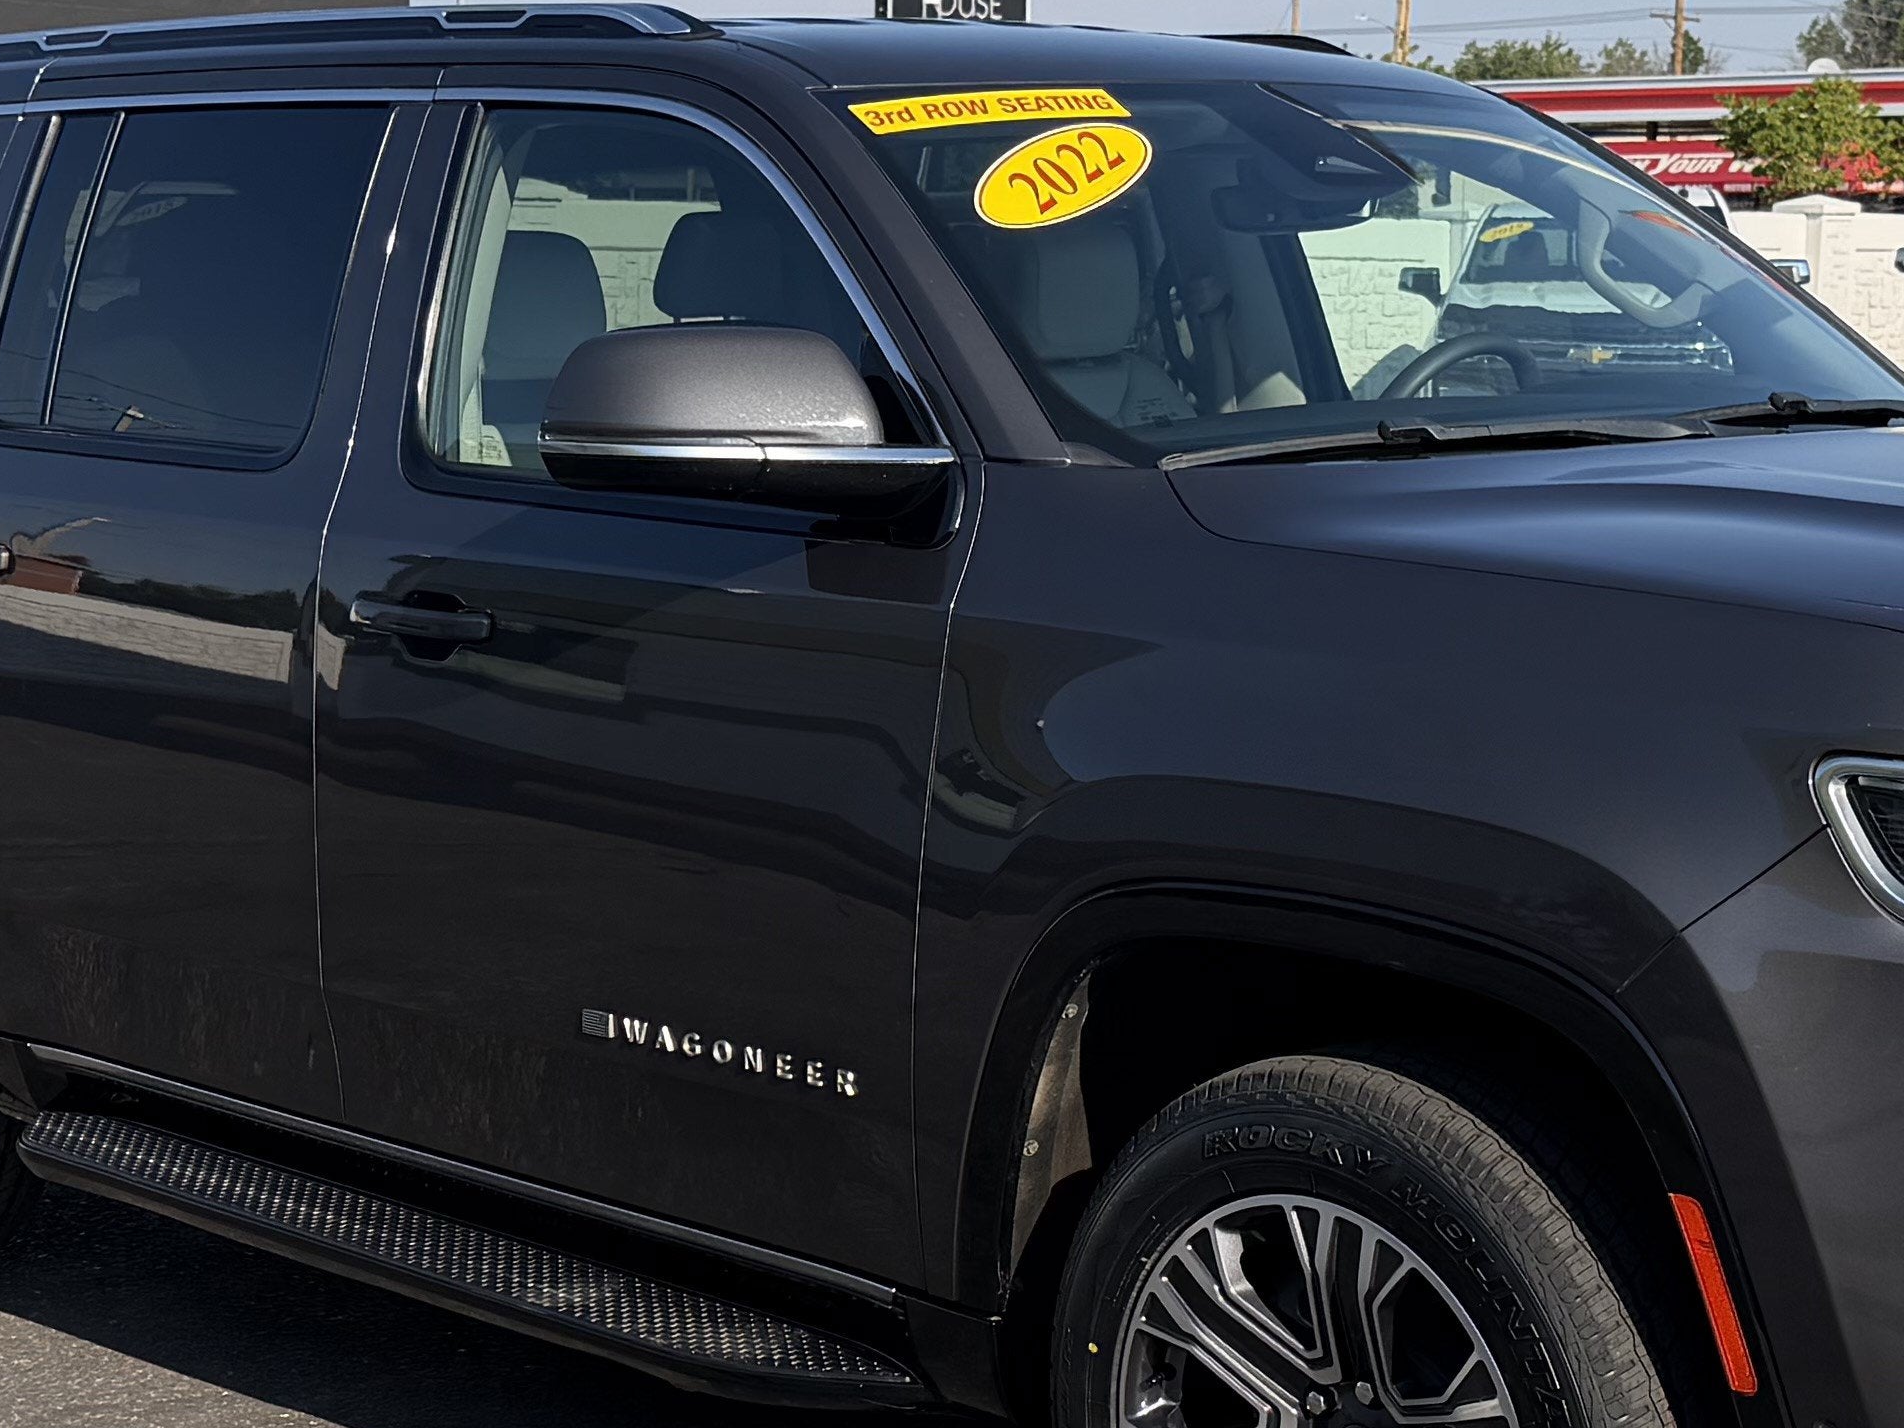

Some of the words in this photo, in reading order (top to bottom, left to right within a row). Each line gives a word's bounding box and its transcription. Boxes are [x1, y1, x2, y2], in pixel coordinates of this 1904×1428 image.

[863, 105, 917, 128] 3rd
[921, 98, 989, 121] ROW
[996, 93, 1115, 114] SEATING
[1008, 130, 1126, 215] 2022
[622, 1017, 859, 1097] WAGONEER
